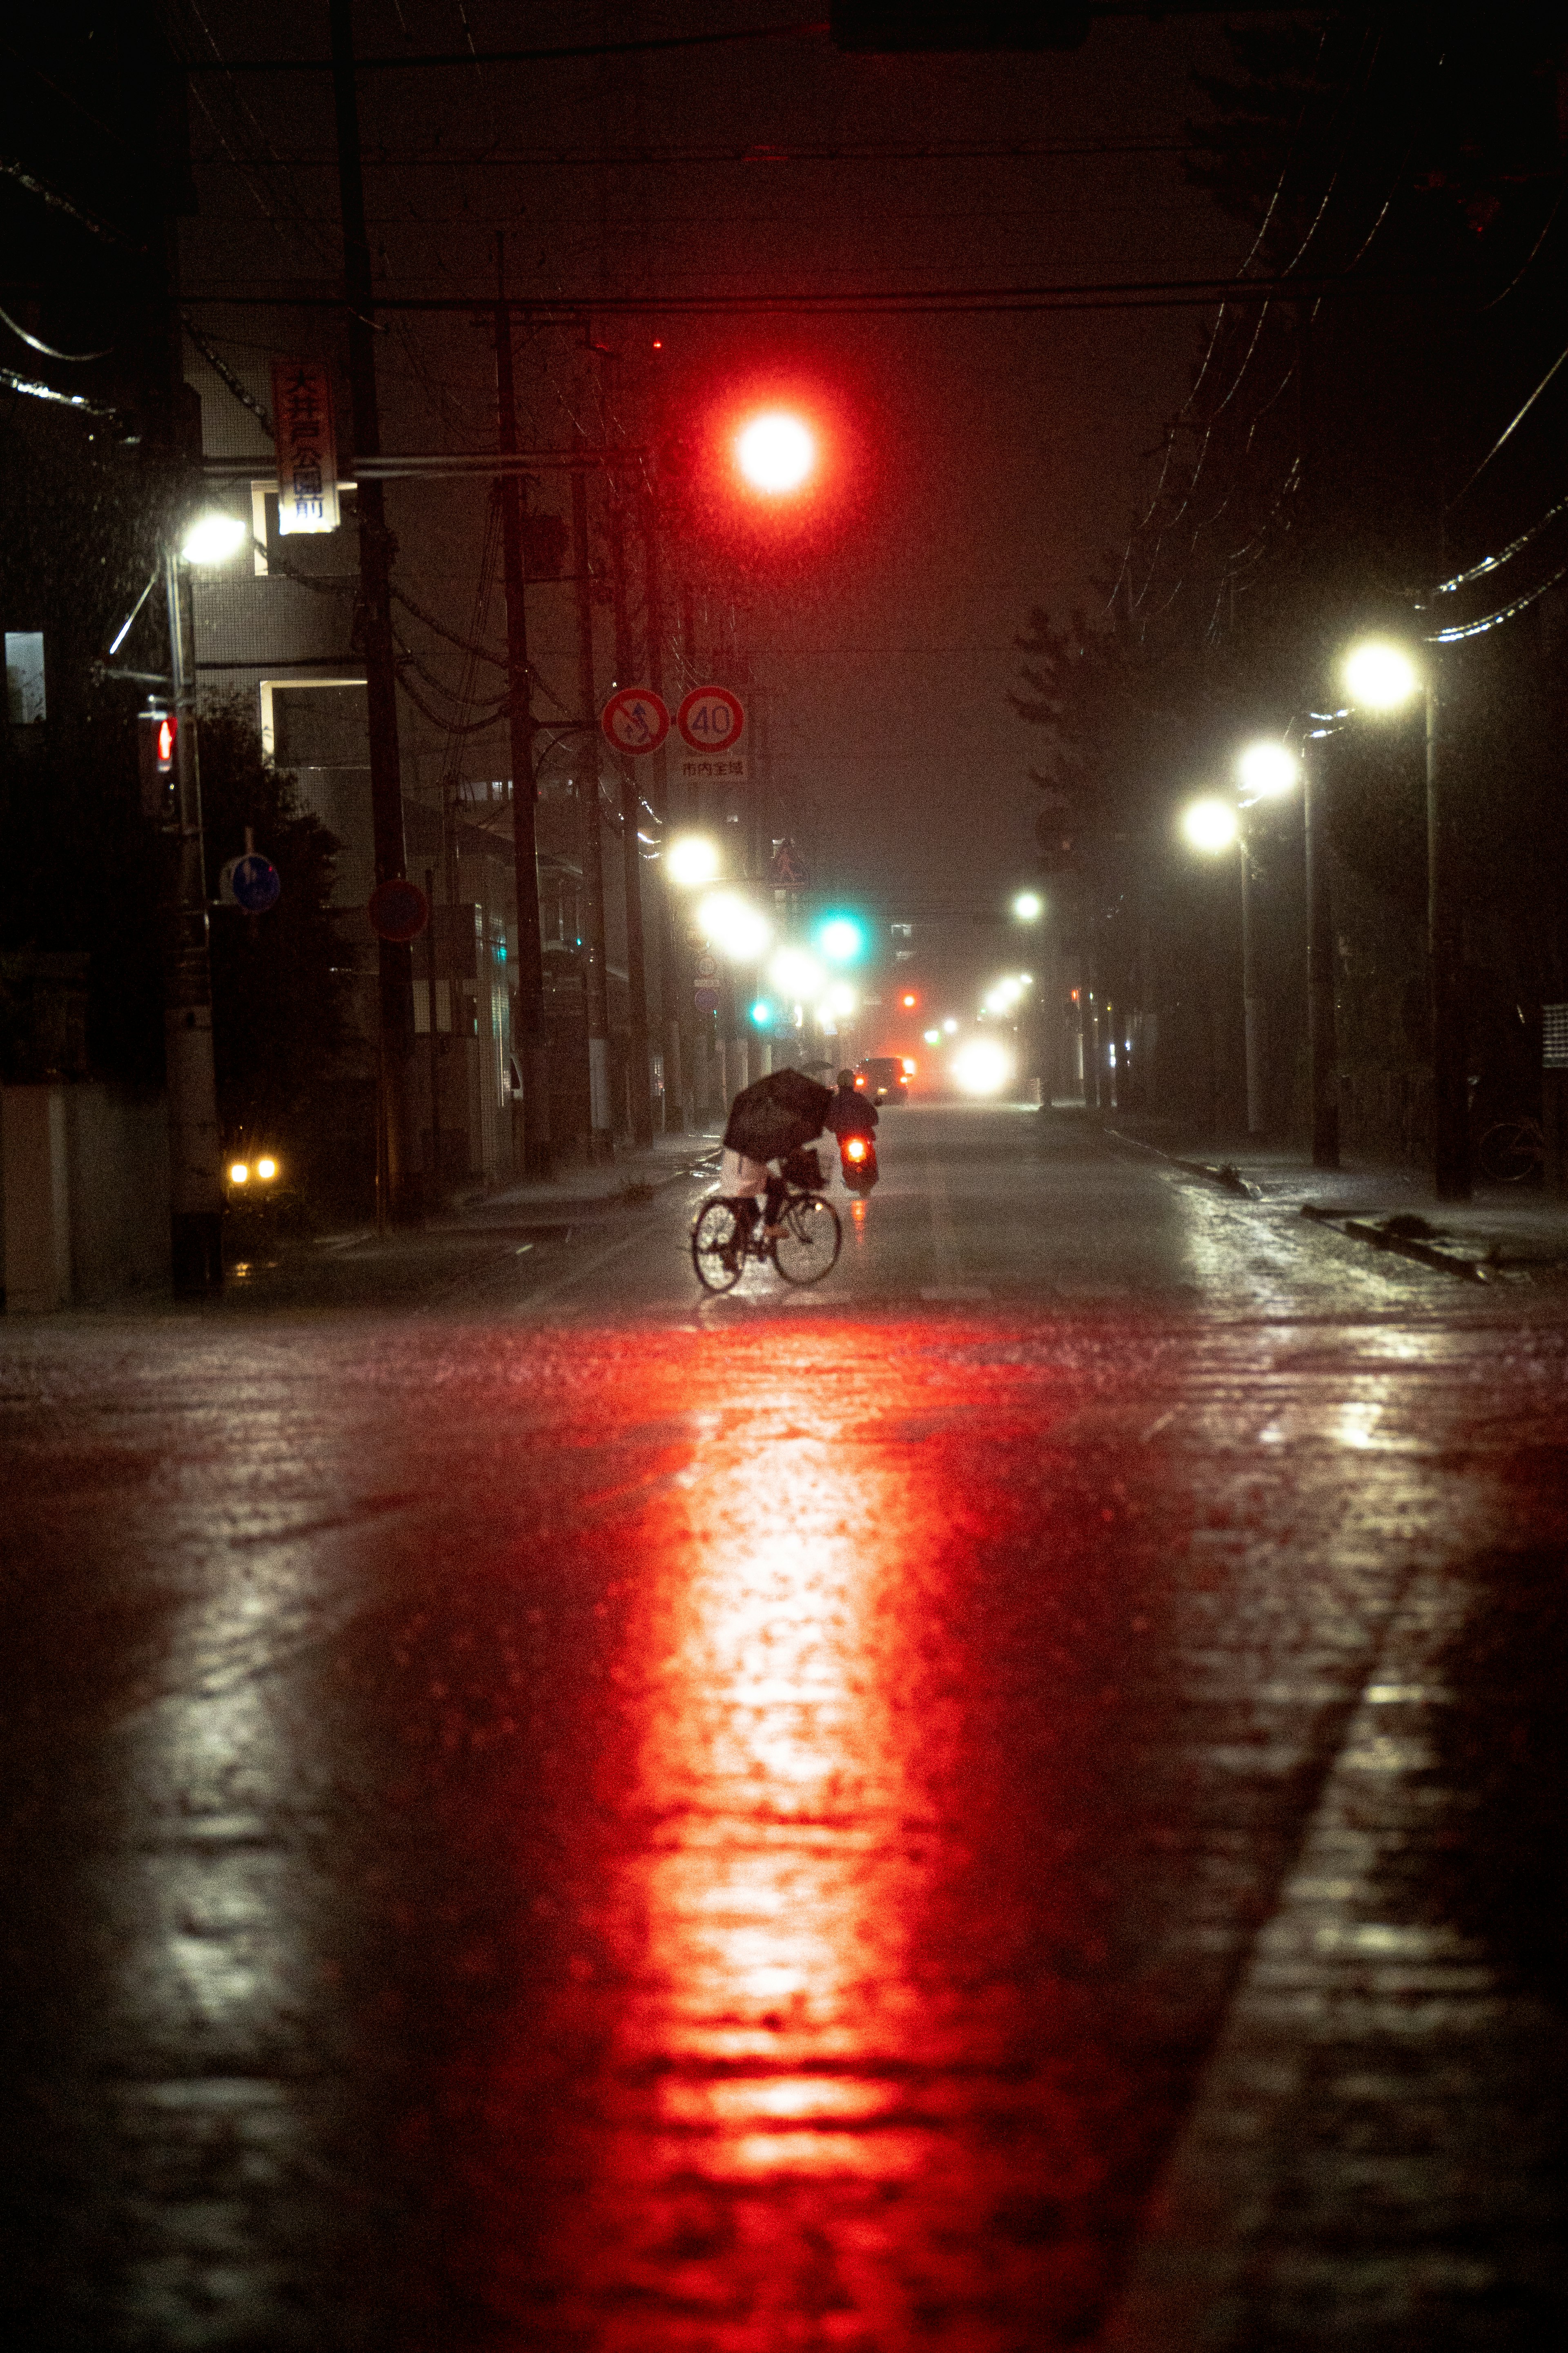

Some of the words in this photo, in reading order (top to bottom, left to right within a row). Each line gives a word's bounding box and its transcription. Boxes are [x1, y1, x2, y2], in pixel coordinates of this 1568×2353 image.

[692, 706, 730, 734] 40
[683, 761, 744, 776] 市内全域
